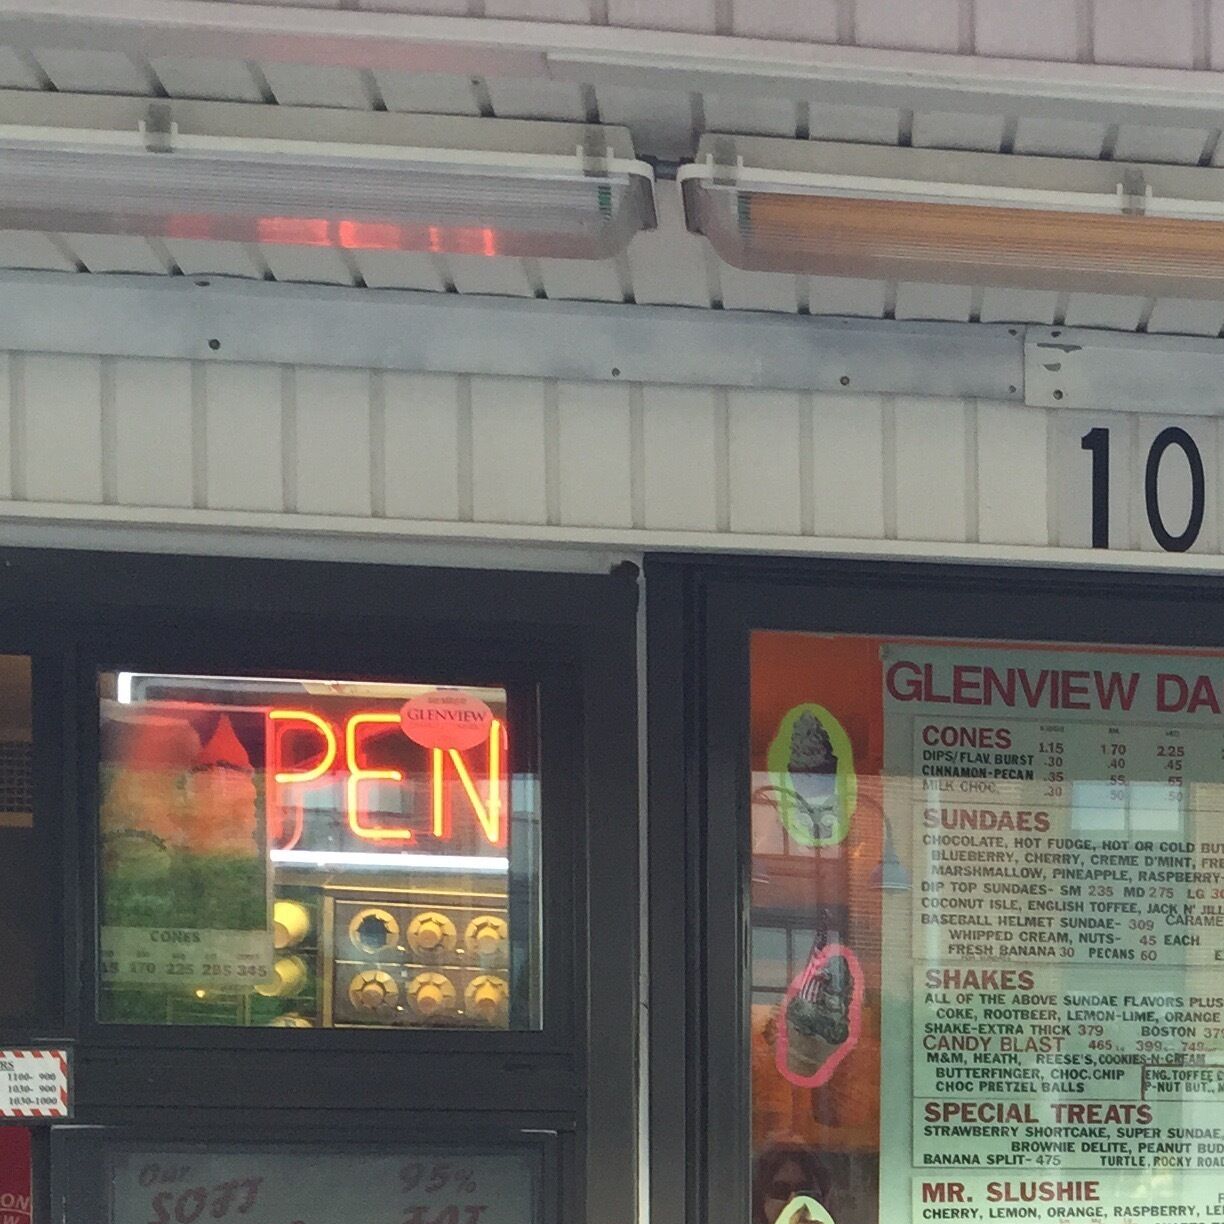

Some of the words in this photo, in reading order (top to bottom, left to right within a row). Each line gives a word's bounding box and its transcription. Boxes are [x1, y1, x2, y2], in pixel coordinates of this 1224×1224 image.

[885, 661, 1141, 711] GLENVIEW
[407, 709, 486, 721] GLENVIEW
[922, 725, 1012, 749] CONES
[268, 709, 508, 843] PEN
[924, 808, 1050, 832] SUNDAES
[151, 931, 200, 944] CONES
[925, 969, 1034, 991] SHAKES
[924, 1035, 996, 1051] CANDY
[1000, 1036, 1064, 1052] BLAST
[924, 1102, 1039, 1124] SPECIAL
[1052, 1103, 1153, 1124] TREATS
[139, 1163, 191, 1187] Our
[400, 1162, 477, 1194] 95%
[923, 1183, 972, 1203] MR.
[986, 1181, 1100, 1201] SLUSHIE
